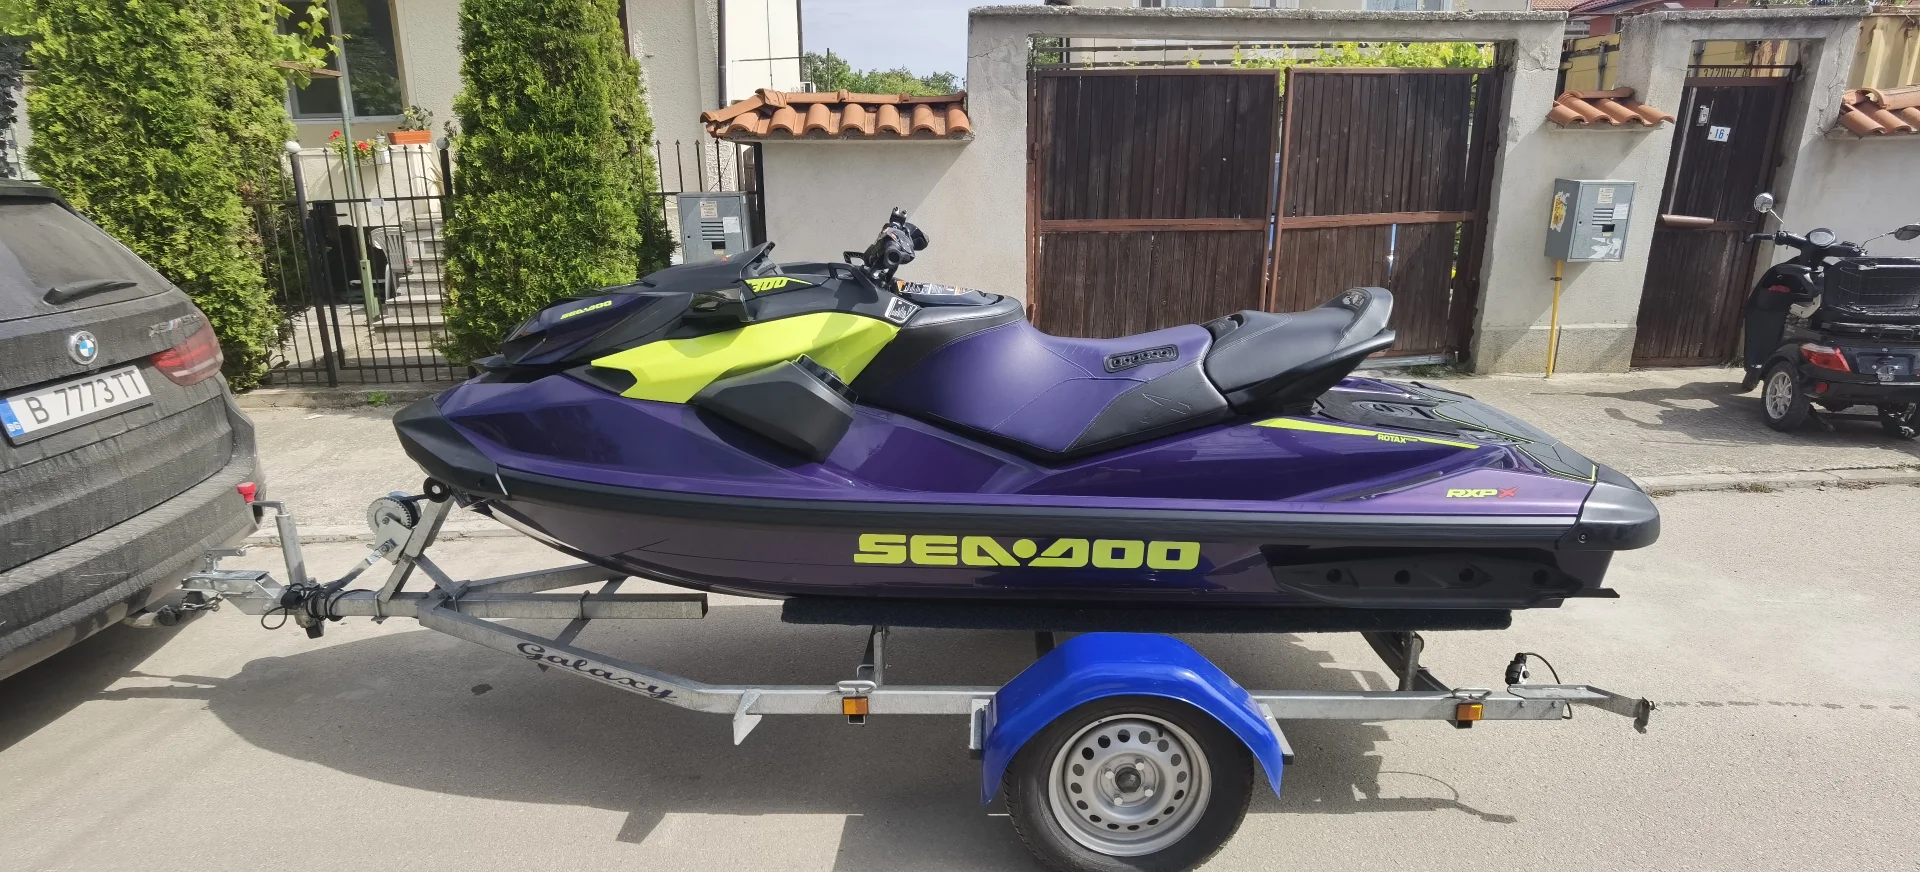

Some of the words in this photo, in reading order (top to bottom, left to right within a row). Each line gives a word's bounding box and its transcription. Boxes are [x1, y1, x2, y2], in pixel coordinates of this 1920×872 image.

[1714, 128, 1725, 140] 16
[24, 396, 50, 425] B
[6, 421, 22, 433] BG
[1377, 433, 1407, 444] ROTAX
[516, 642, 678, 699] Galaxy
